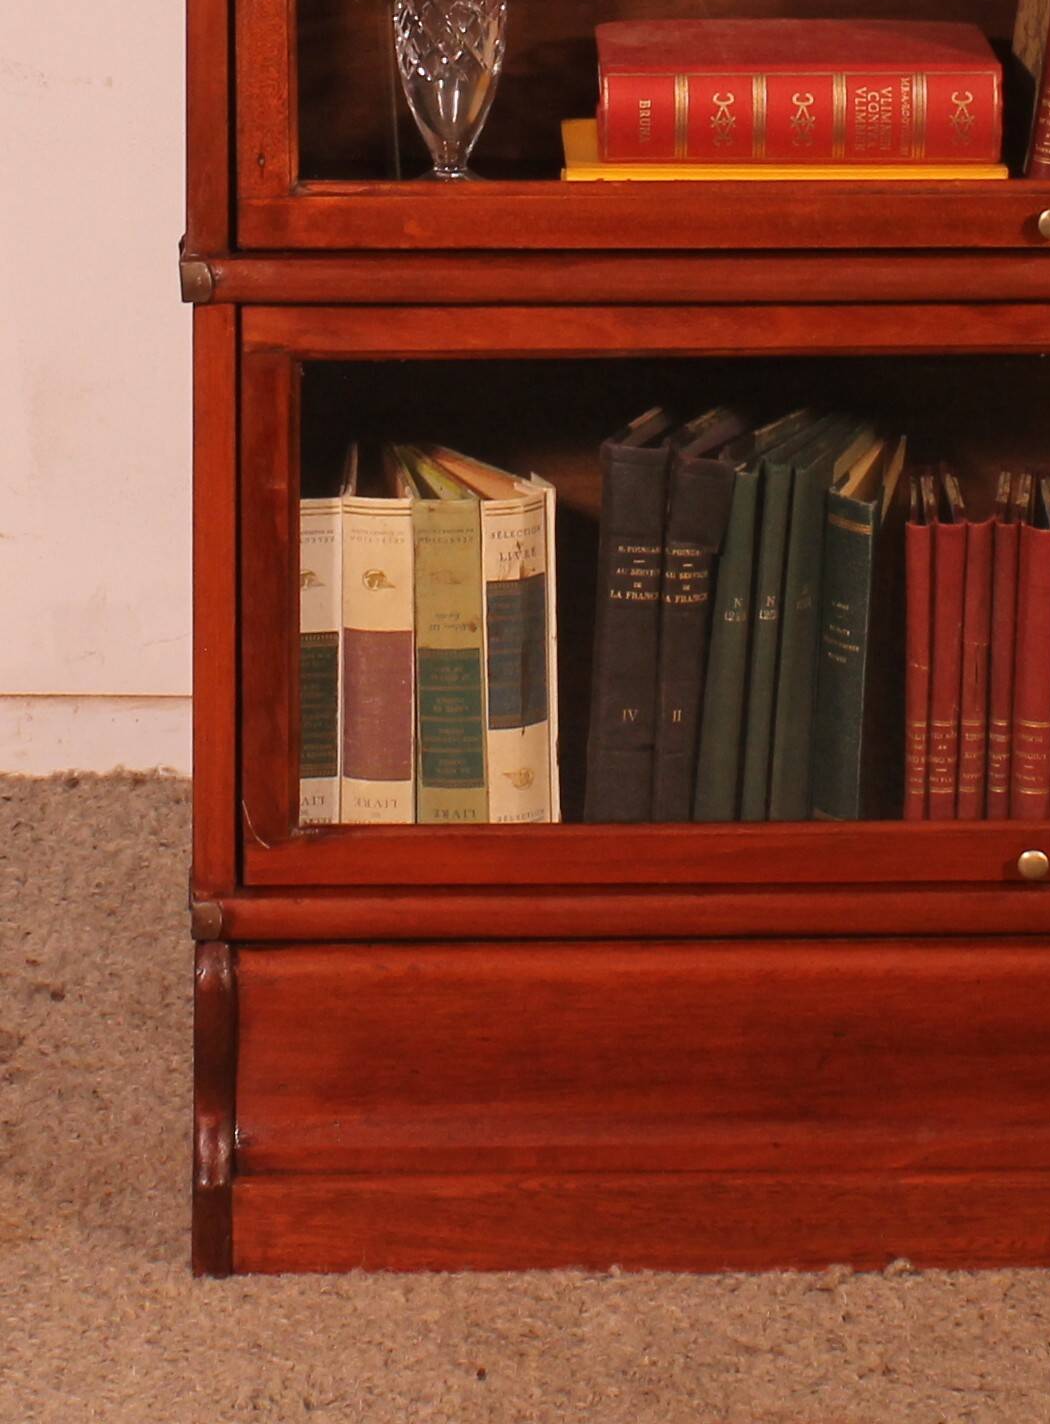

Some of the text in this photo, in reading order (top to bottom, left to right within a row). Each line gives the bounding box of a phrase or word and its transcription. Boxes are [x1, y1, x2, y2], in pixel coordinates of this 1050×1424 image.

[638, 98, 651, 145] BRUNA
[622, 708, 639, 723] IV
[672, 708, 682, 723] II
[352, 795, 399, 809] LIVRE
